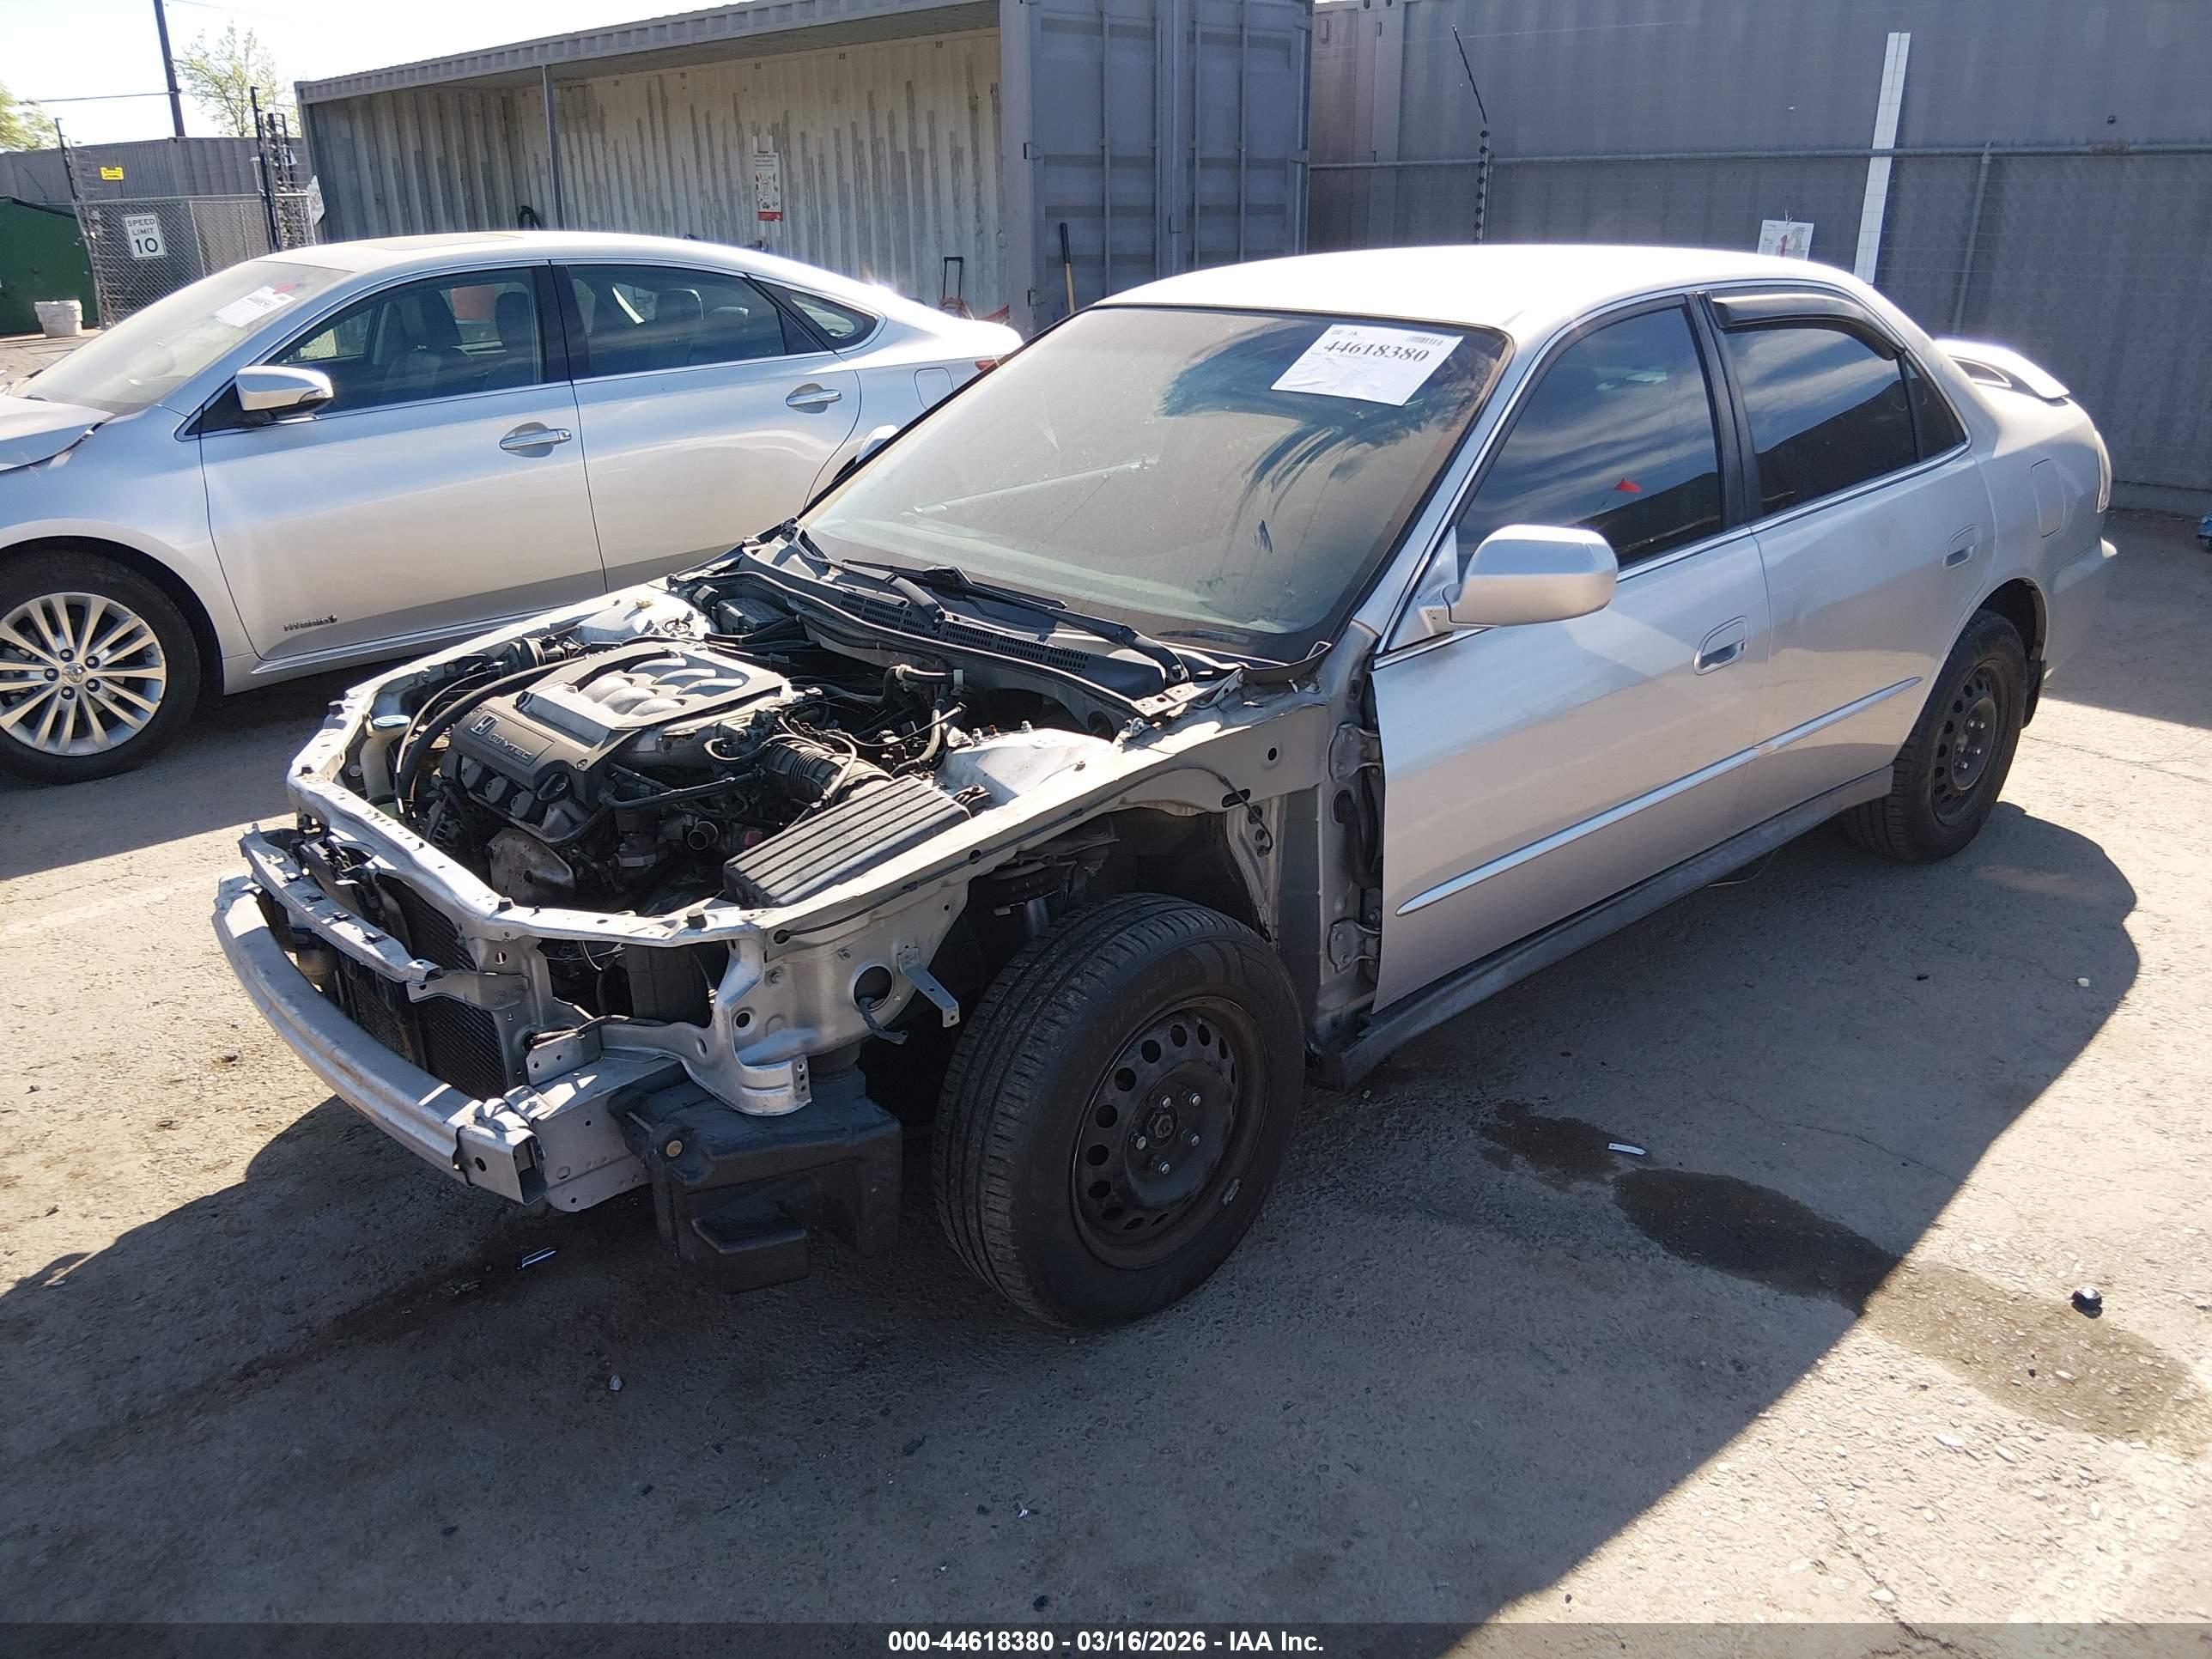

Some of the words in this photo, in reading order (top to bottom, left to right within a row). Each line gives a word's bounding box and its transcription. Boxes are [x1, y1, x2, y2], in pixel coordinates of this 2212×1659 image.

[127, 218, 155, 228] SPEED
[131, 227, 154, 236] LIMIT
[135, 237, 159, 254] 10
[1324, 340, 1430, 362] 44618380
